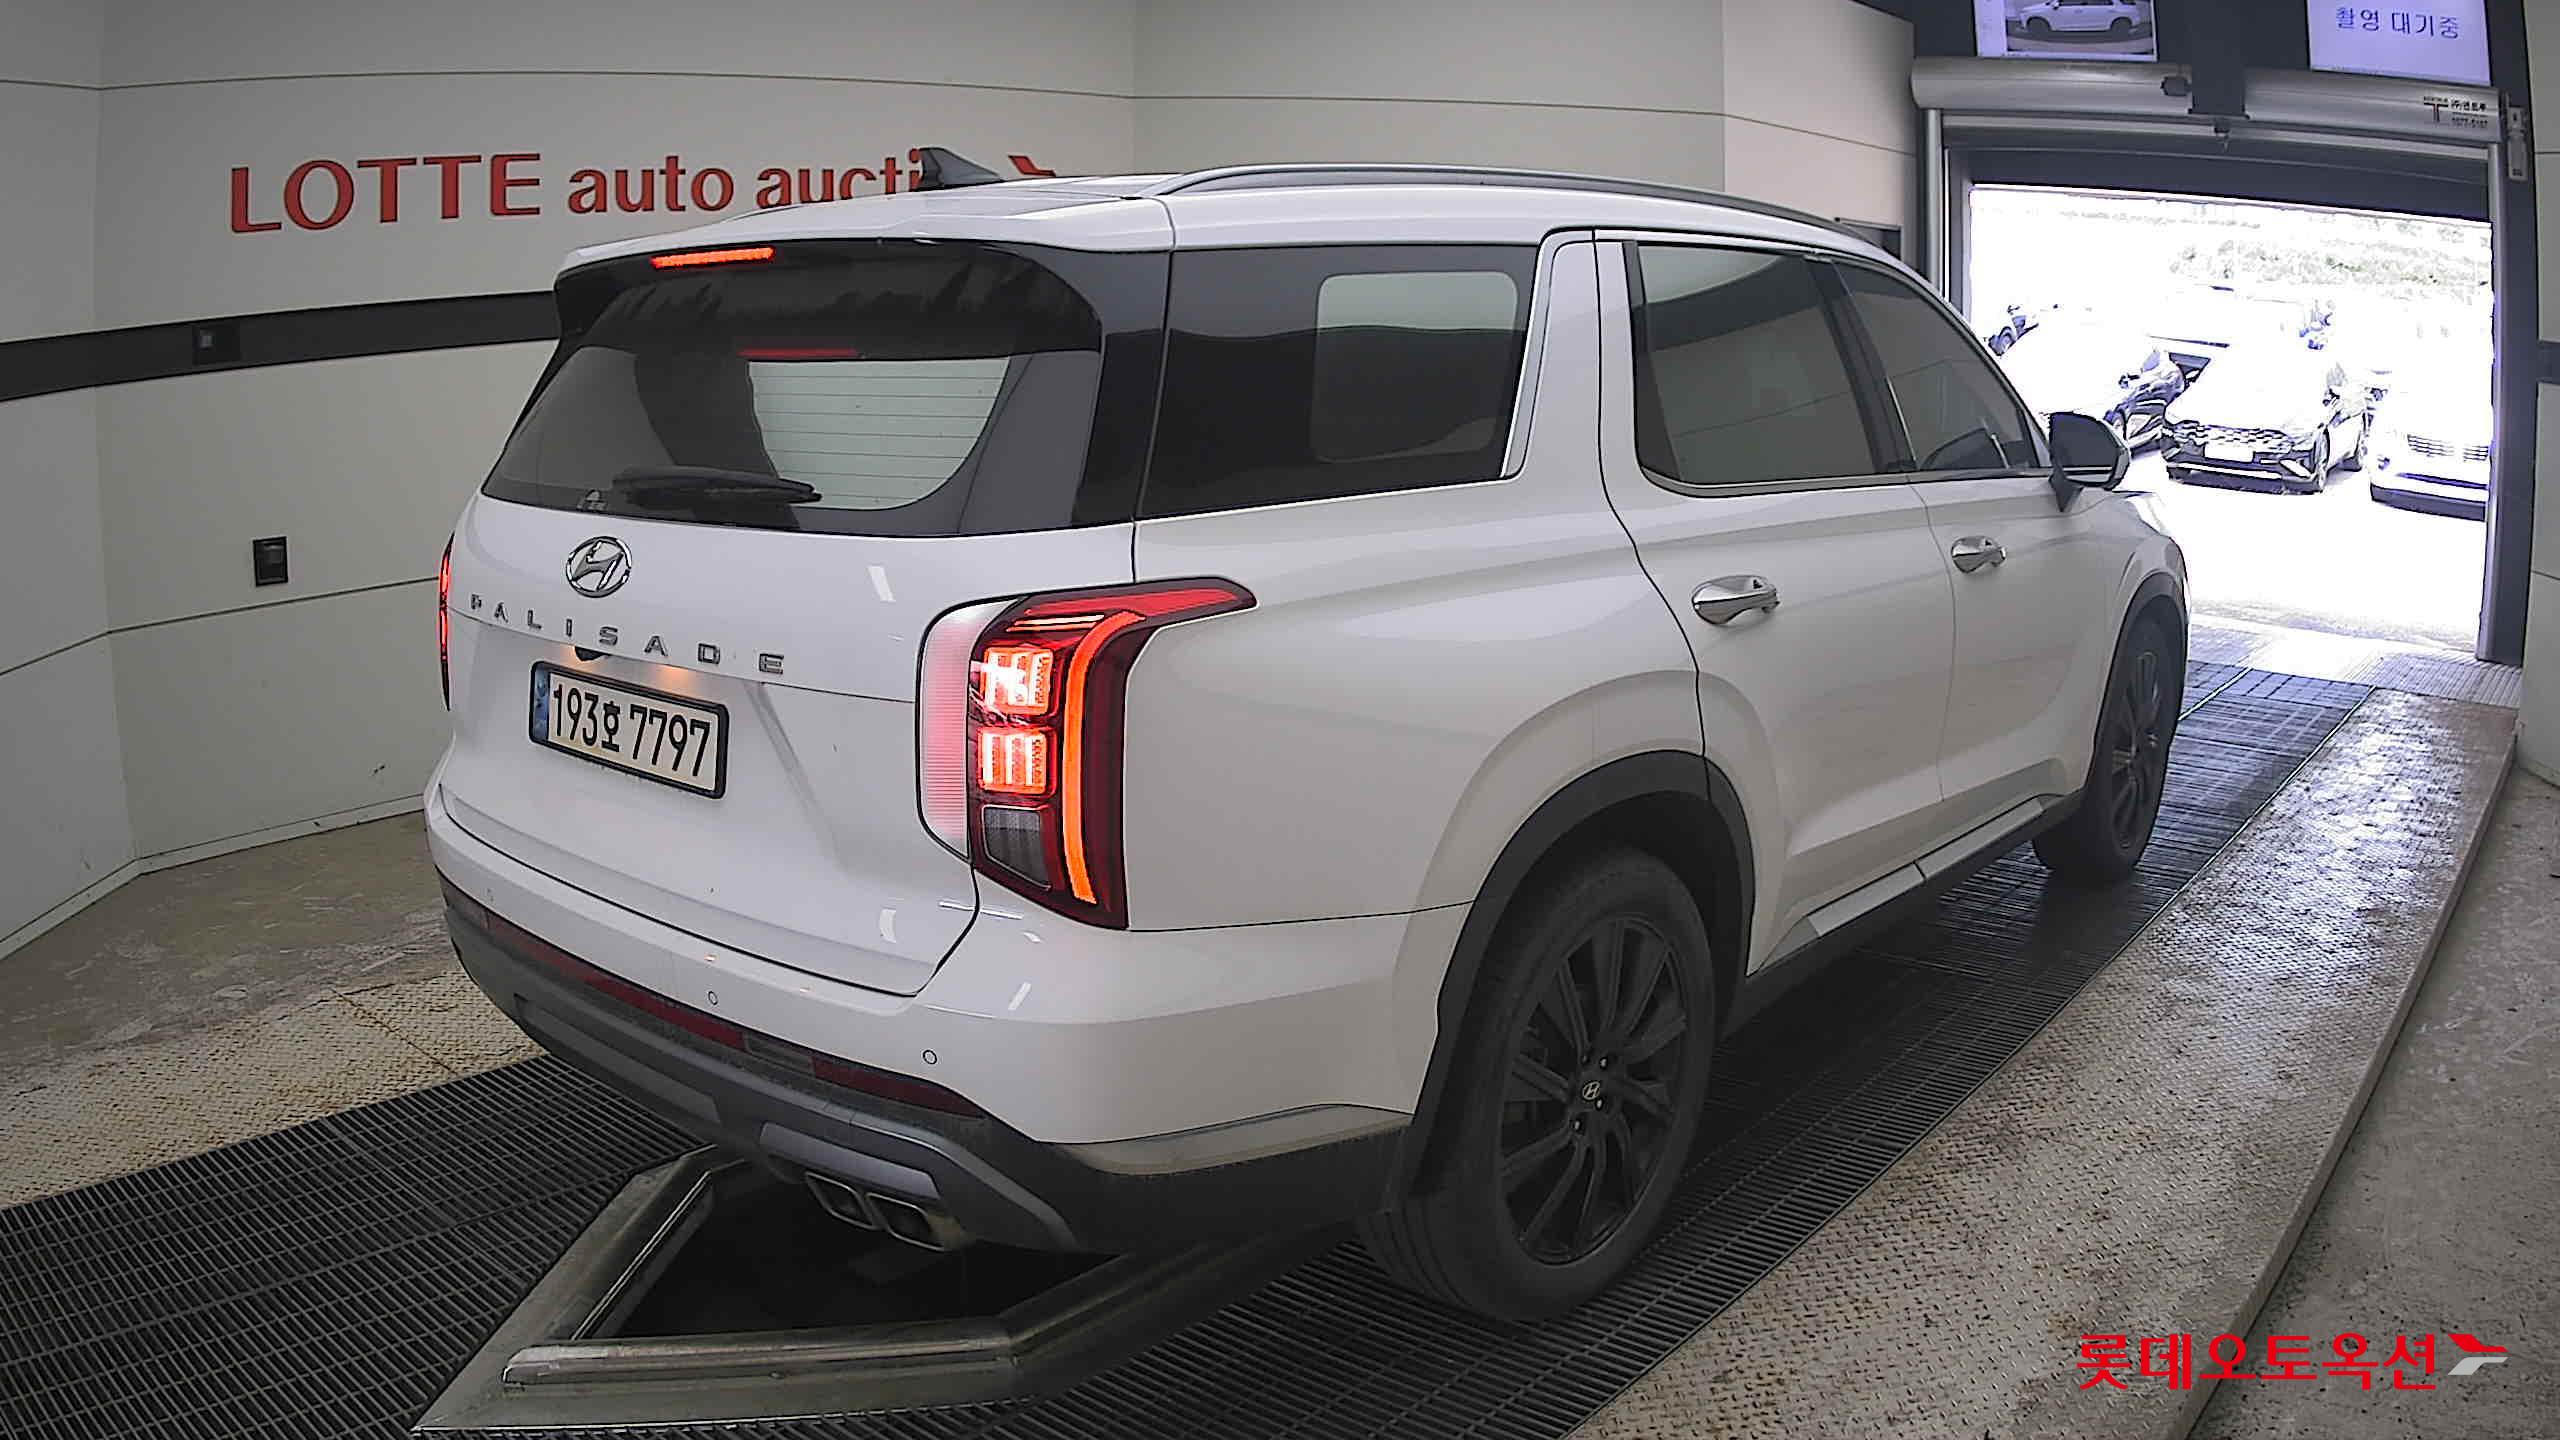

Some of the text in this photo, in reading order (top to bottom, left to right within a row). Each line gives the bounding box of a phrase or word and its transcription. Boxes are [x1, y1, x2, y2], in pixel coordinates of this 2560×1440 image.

[2336, 7, 2459, 39] 촬영 대기중
[230, 148, 923, 235] LOTTE auto aucti
[470, 593, 785, 676] PALISADE
[553, 684, 711, 778] 193호 7797
